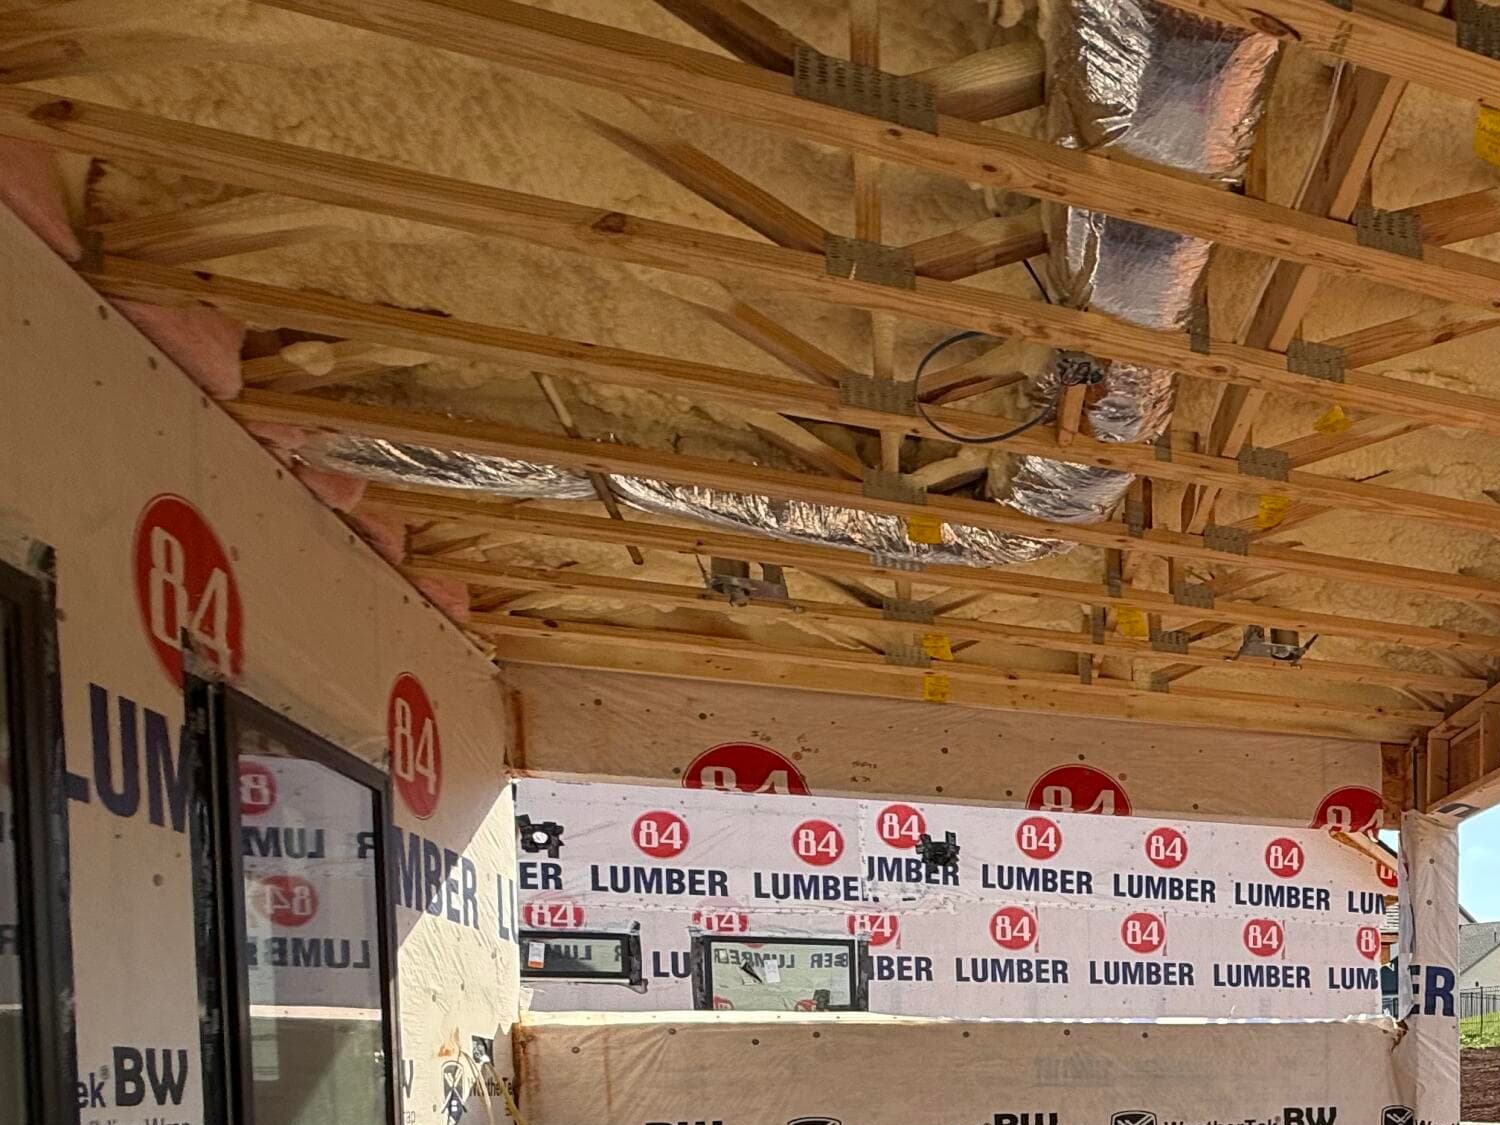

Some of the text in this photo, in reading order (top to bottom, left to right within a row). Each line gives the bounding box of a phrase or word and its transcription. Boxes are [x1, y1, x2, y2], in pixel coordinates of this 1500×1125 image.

[149, 526, 232, 678] 84
[395, 697, 437, 795] 84
[639, 813, 1299, 870] 84 84 84 84 84 84
[591, 864, 728, 897] LUMBER
[754, 872, 879, 902] LUMBE
[982, 864, 1093, 894] LUMBER
[1113, 873, 1216, 903] LUMBER
[1235, 882, 1330, 910] LUMBER
[995, 915, 1031, 942] 84
[1126, 920, 1159, 945] 84
[1248, 925, 1279, 949] 84
[1361, 929, 1376, 952] 8
[869, 956, 933, 981] BER
[956, 957, 1069, 984] LUMBER
[1090, 961, 1194, 986] LUMBER
[1213, 964, 1311, 988] LUMBER
[113, 1046, 188, 1107] BW
